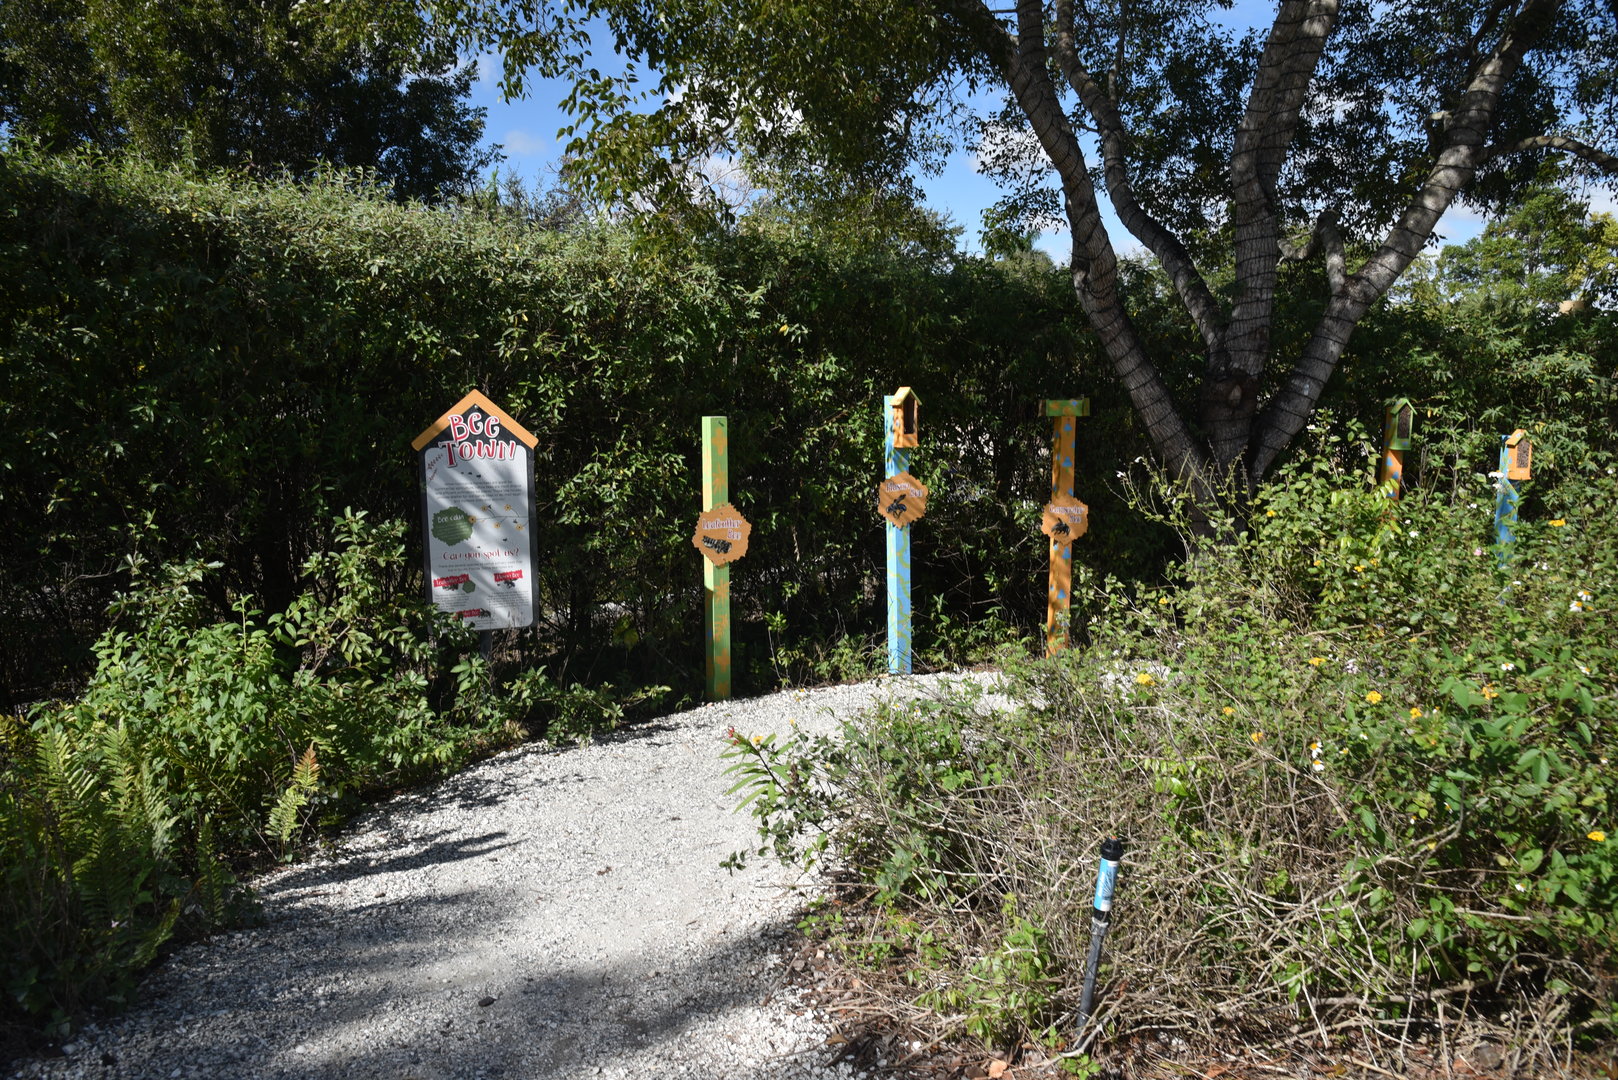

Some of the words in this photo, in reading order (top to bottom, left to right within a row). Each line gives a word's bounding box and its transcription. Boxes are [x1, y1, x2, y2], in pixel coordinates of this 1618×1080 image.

[727, 529, 742, 540] Bee
[443, 551, 462, 561] Can
[463, 551, 481, 562] you
[482, 549, 500, 561] spot
[504, 547, 520, 557] us?
